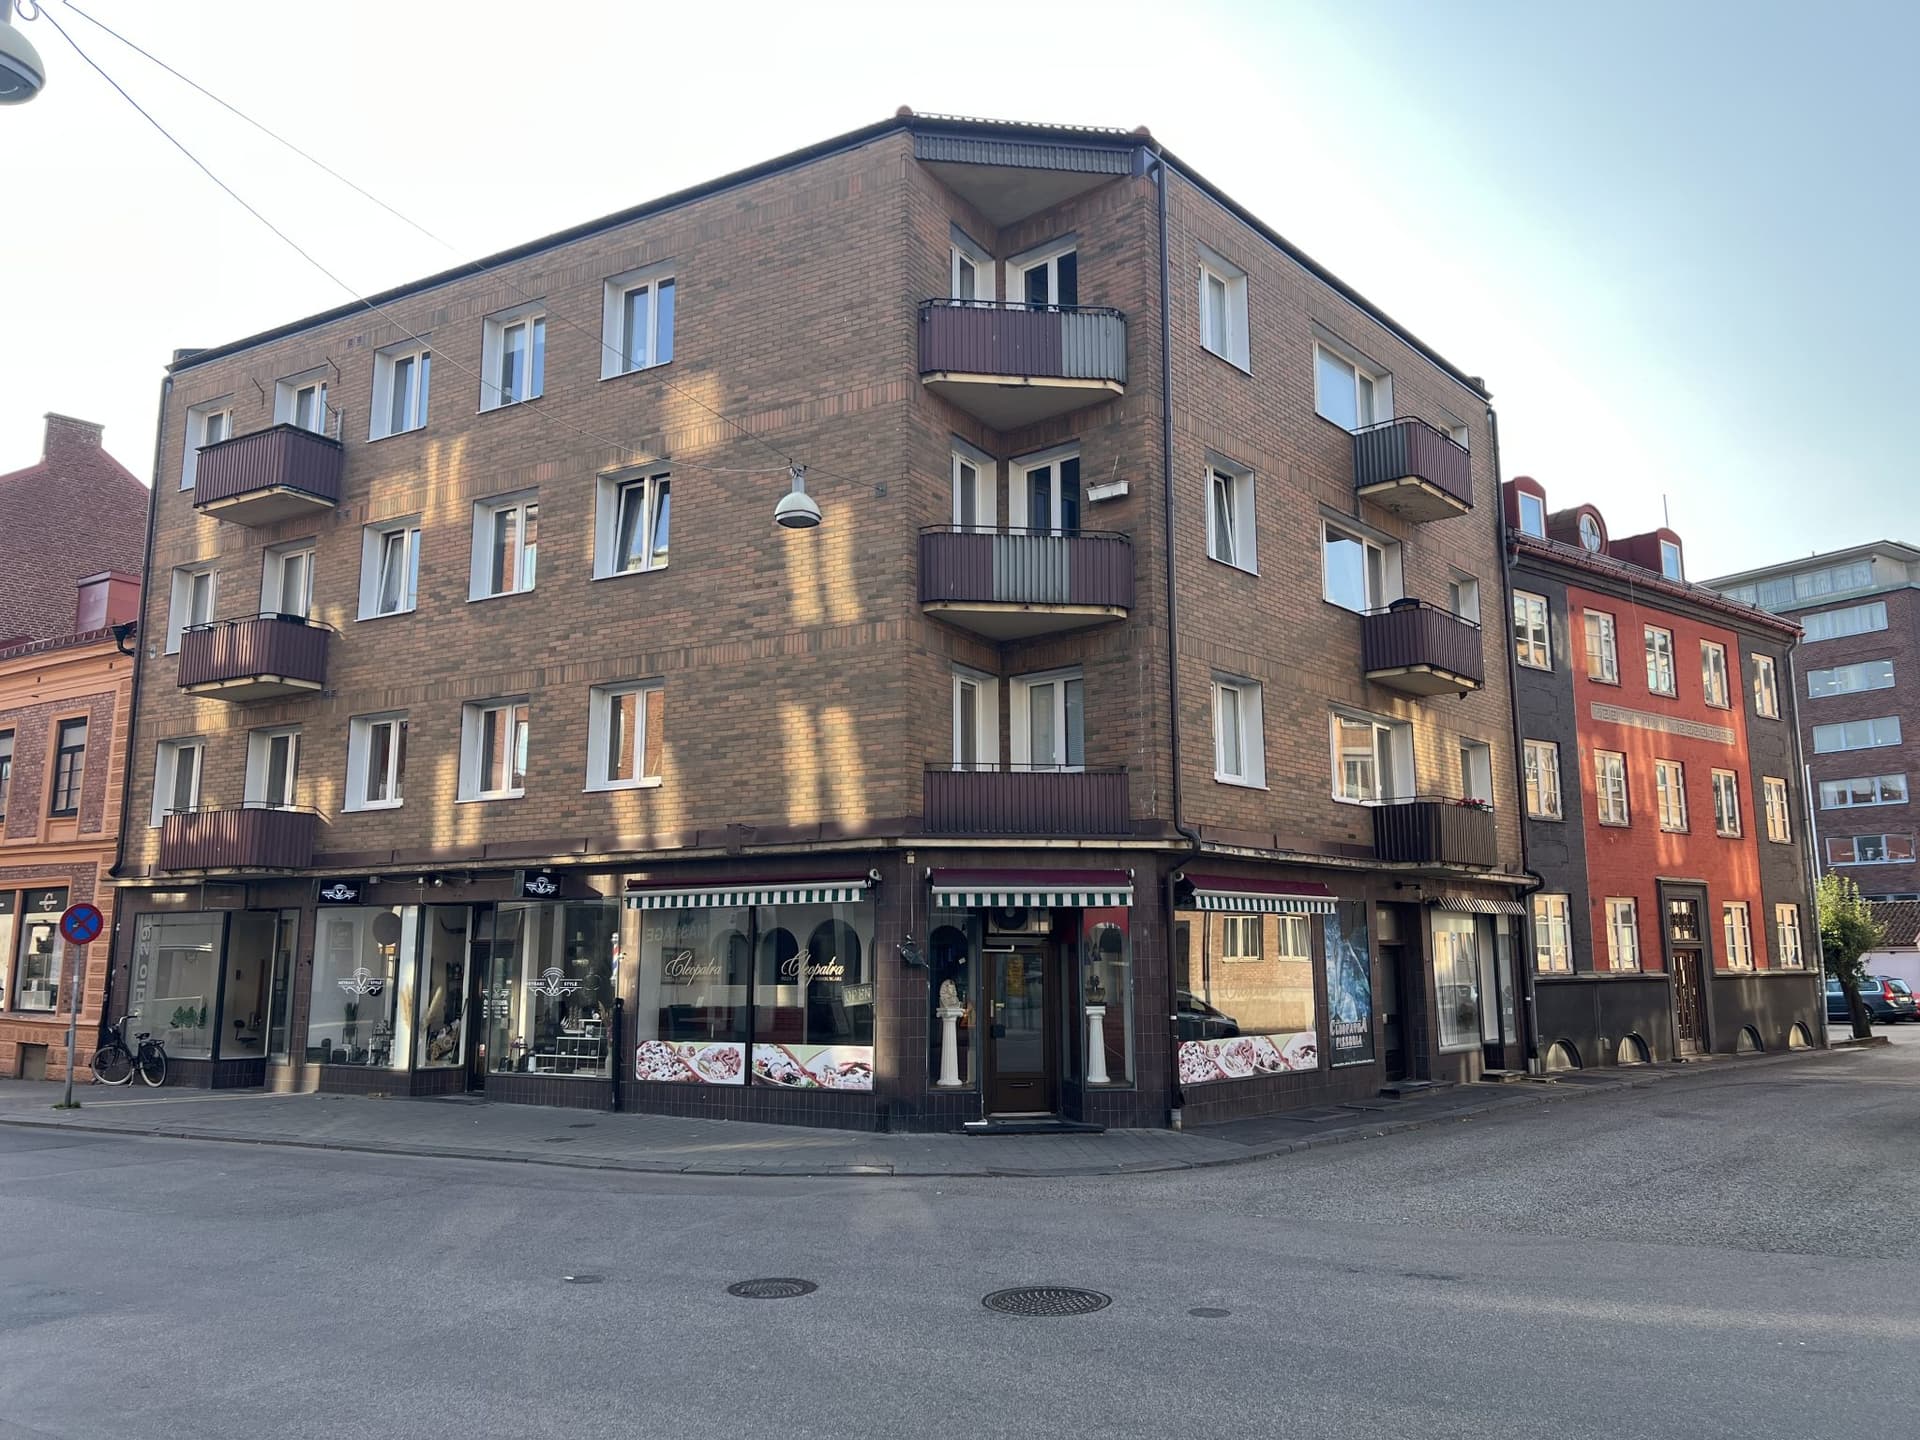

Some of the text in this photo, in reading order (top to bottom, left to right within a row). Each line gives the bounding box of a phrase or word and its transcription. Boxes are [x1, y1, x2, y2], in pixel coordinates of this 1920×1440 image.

[140, 926, 152, 955] 29
[664, 950, 722, 987] Cleopatra
[781, 949, 845, 987] Cleopatra
[846, 988, 872, 1002] OPEN
